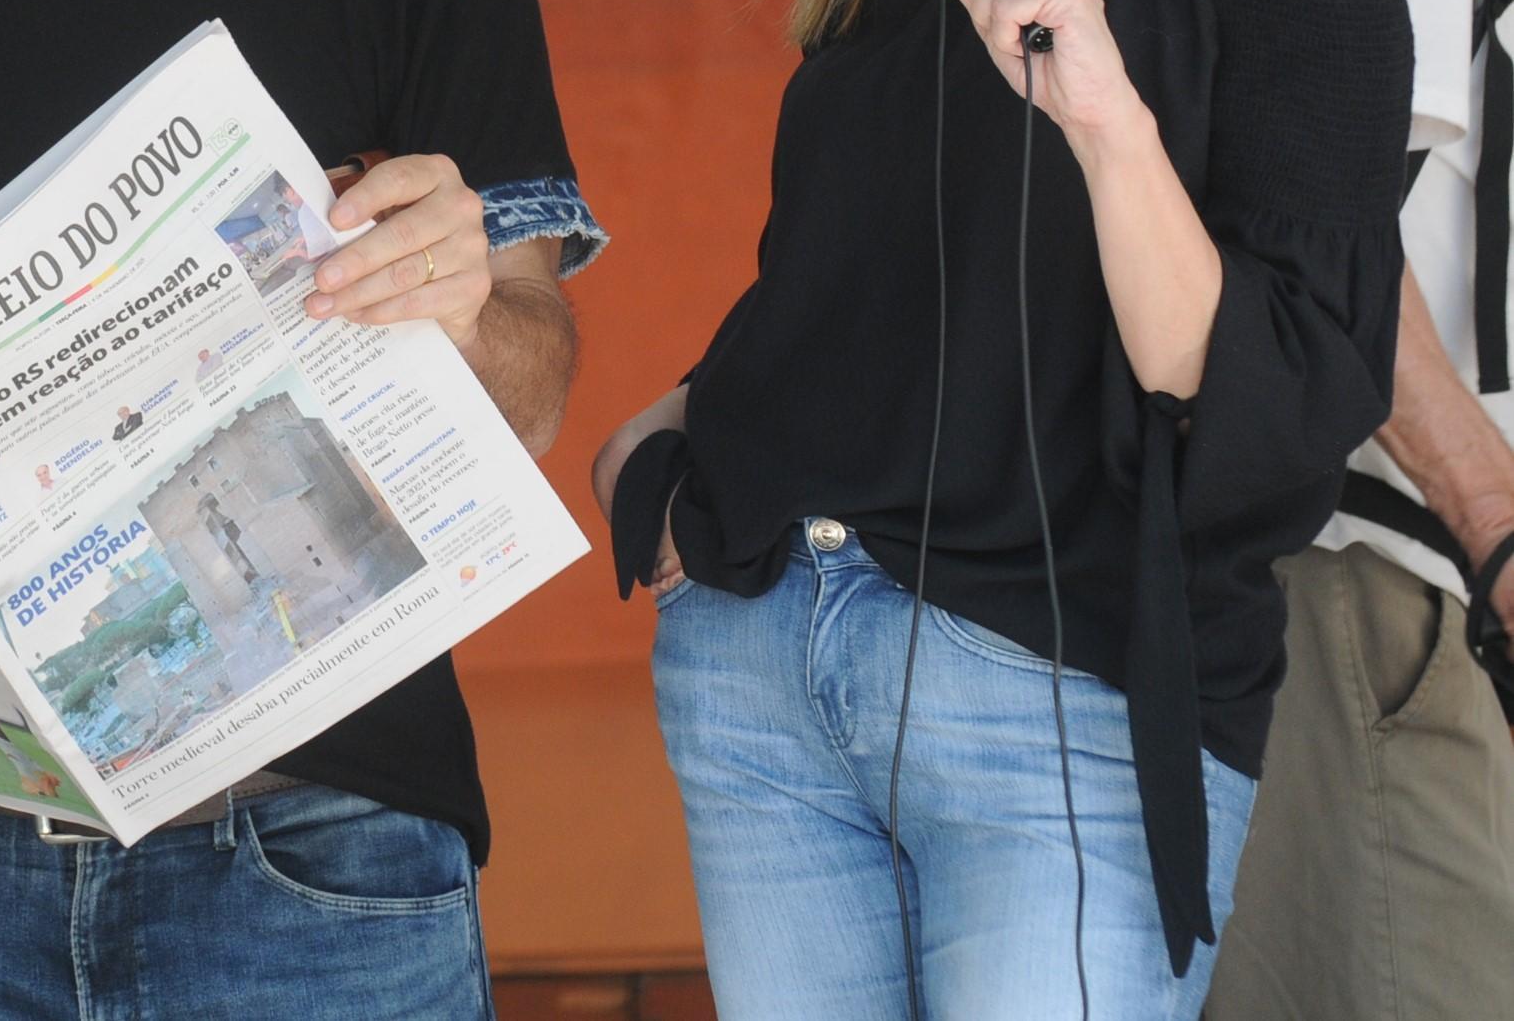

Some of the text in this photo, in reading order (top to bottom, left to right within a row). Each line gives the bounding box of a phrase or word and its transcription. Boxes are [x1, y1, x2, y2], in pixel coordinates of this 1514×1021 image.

[58, 201, 118, 272] DO
[108, 115, 205, 220] POVO
[10, 361, 45, 391] RS
[43, 253, 201, 370] redirecionam
[25, 340, 109, 406] reação
[108, 322, 145, 352] ao
[139, 259, 237, 332] tarifaço
[55, 302, 88, 326] TERÇA-FEIRA
[221, 321, 264, 355] MOMBACH
[303, 335, 351, 375] condenado
[311, 361, 339, 385] morte
[350, 323, 391, 356] sobrinho
[325, 343, 386, 390] desconhecido
[139, 378, 178, 409] JURANDIR
[142, 390, 172, 413] SOARES
[53, 438, 90, 467] ROGÉRIO
[58, 438, 103, 474] MENDELSKI
[404, 425, 456, 467] METROPOLITANA
[420, 498, 477, 542] O TEMPO HOJE
[4, 523, 109, 611] 800 ANOS
[15, 517, 147, 627] DE HISTÓRIA
[110, 767, 159, 802] Torre
[158, 728, 226, 775] medieval
[223, 693, 279, 735] desaba
[275, 630, 372, 703] parcialmente
[370, 615, 395, 638] em
[392, 581, 440, 620] Roma
